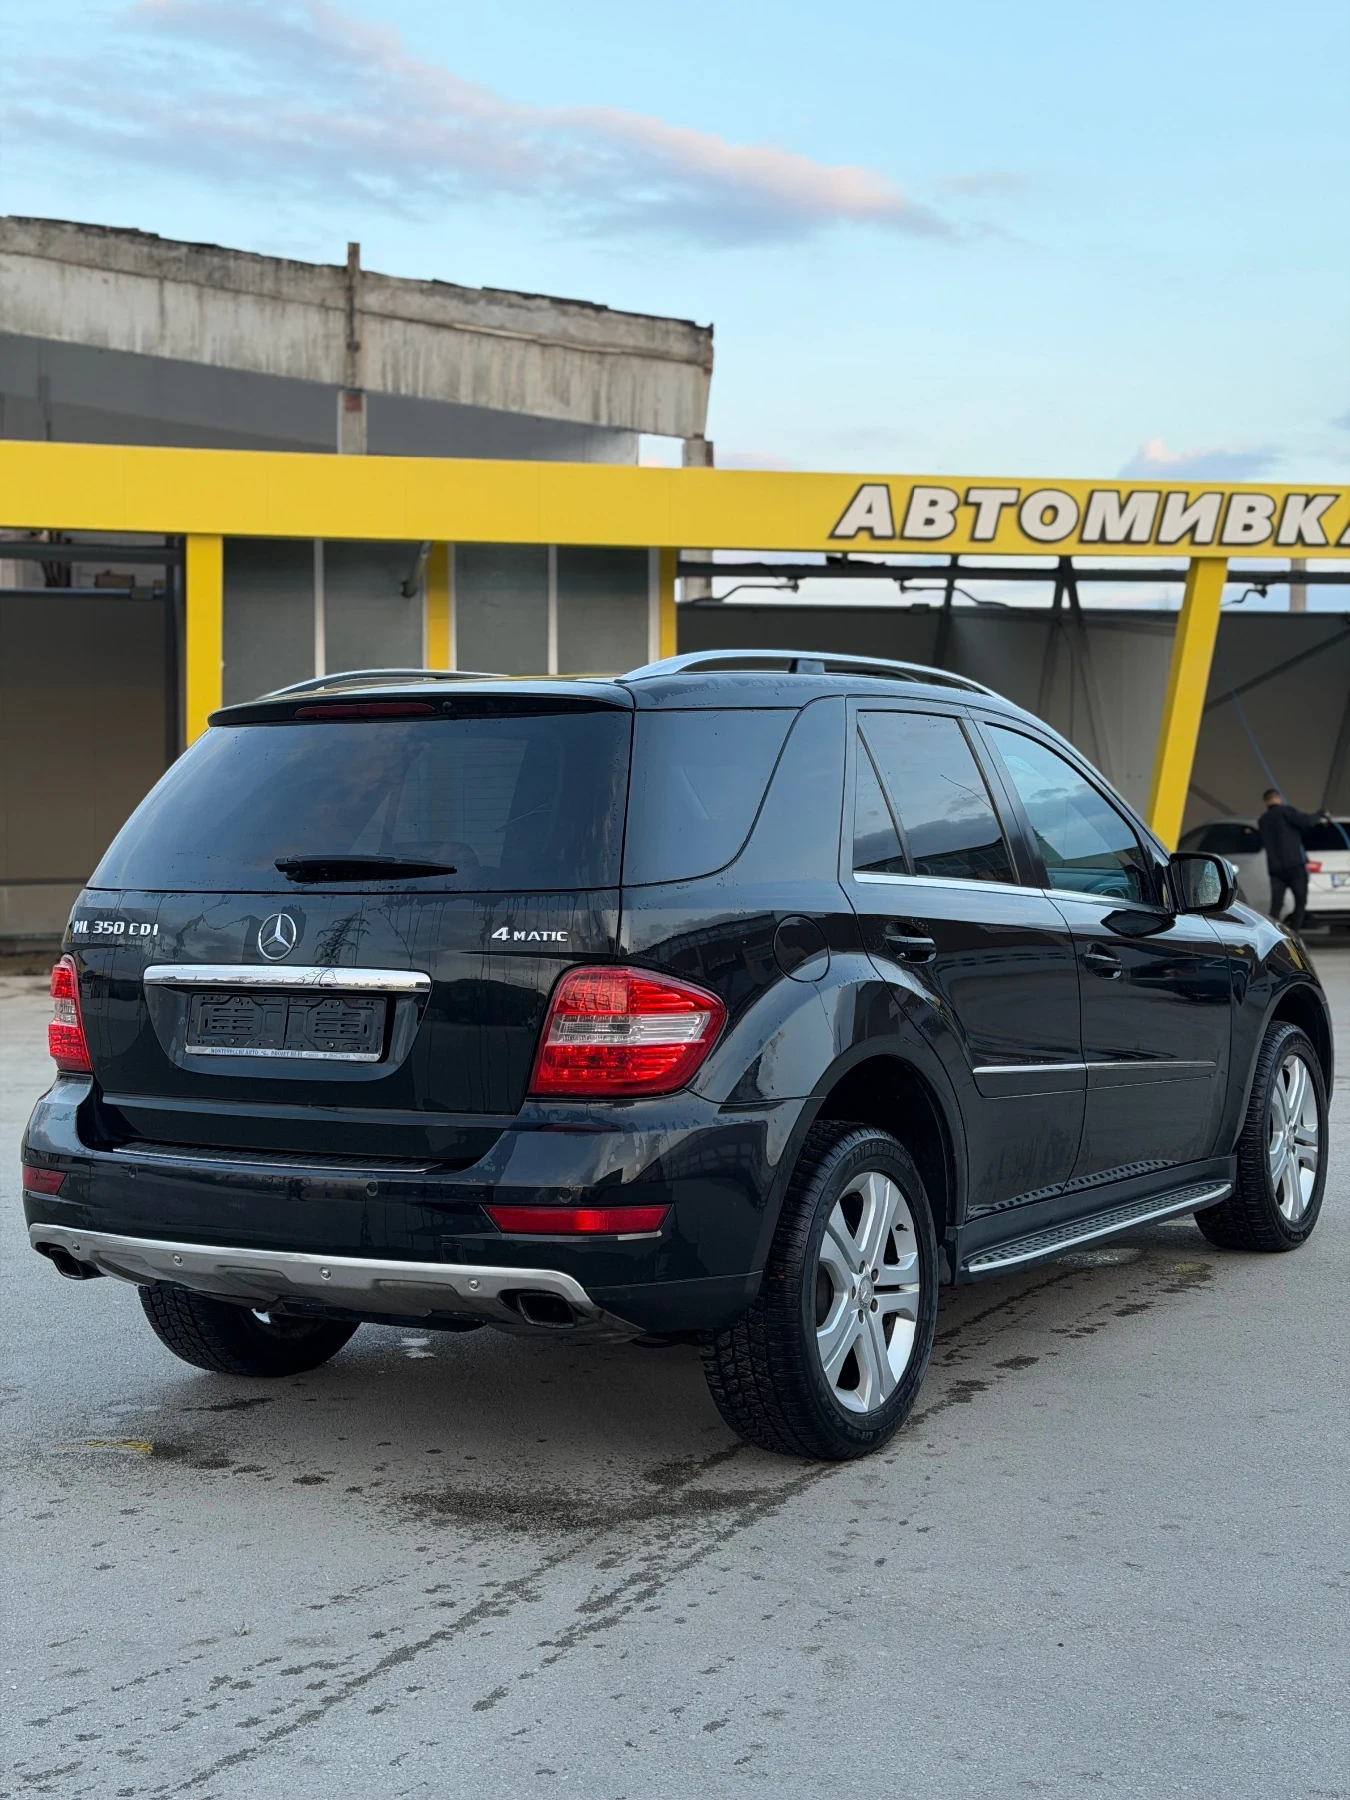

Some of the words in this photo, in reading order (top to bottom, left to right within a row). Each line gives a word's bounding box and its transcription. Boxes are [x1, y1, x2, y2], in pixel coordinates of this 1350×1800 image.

[828, 483, 1350, 546] АВТОМИВК
[73, 920, 89, 934] ML
[92, 920, 125, 935] 350
[128, 923, 159, 936] CDI
